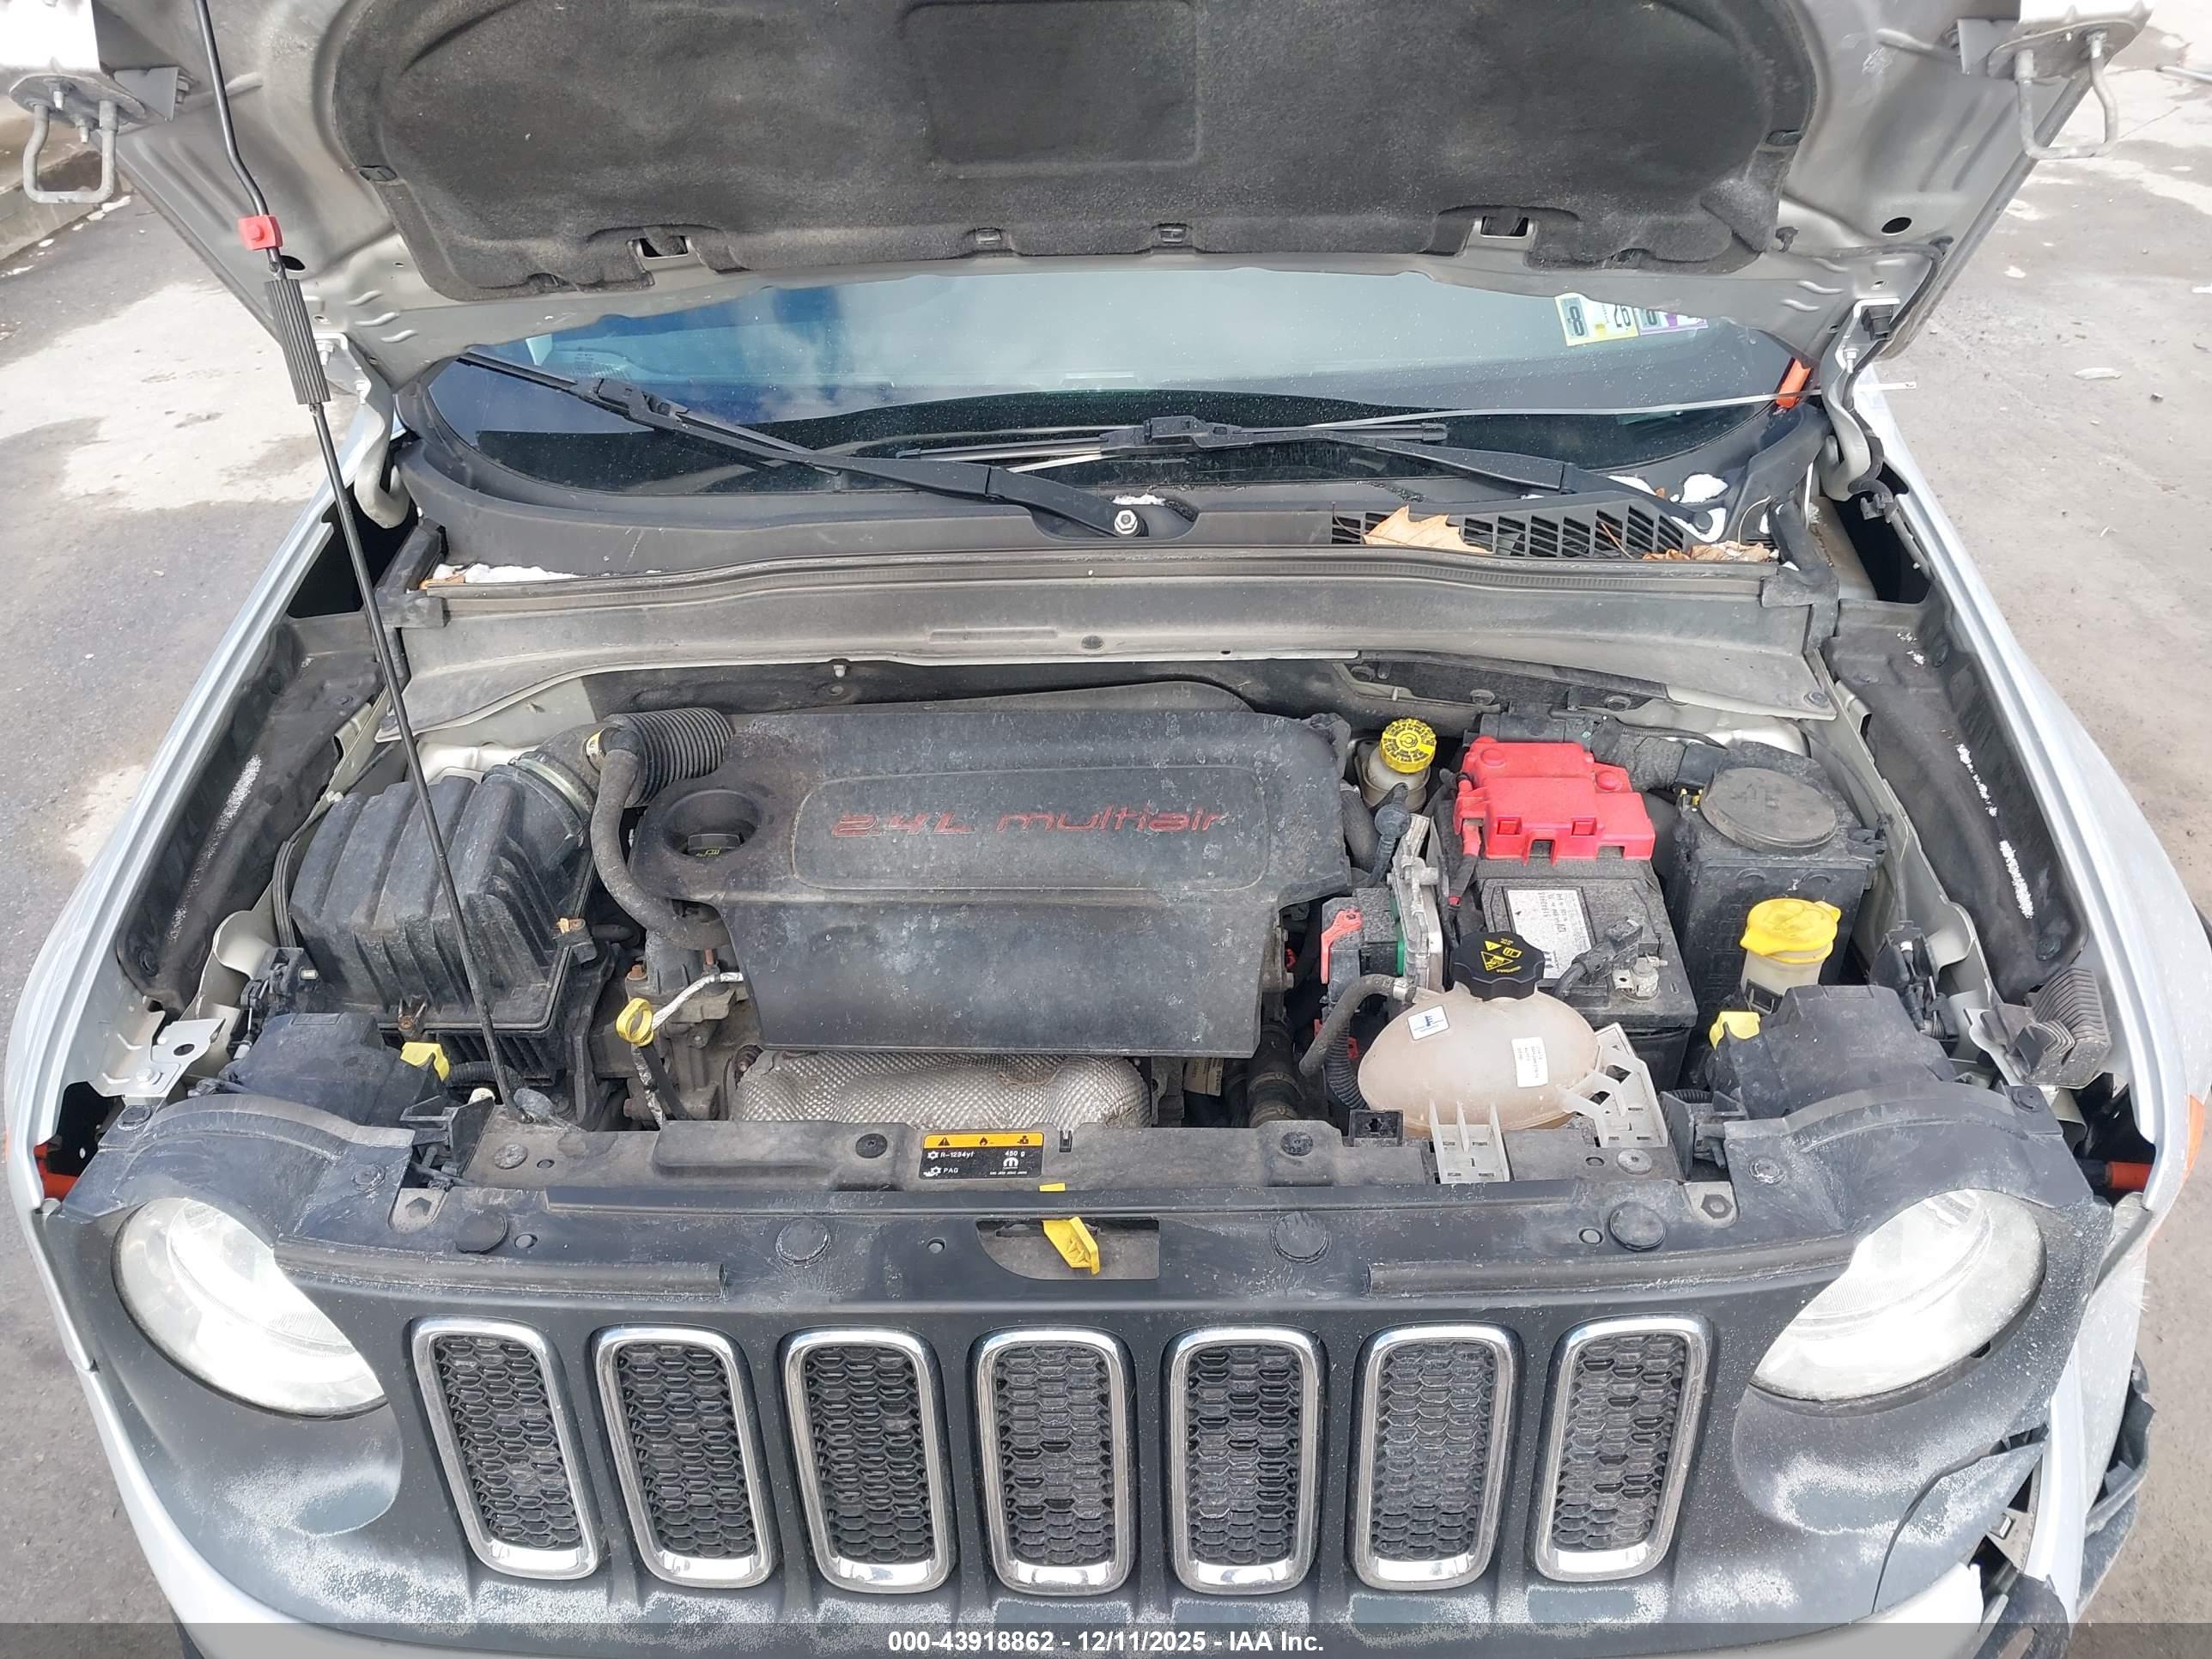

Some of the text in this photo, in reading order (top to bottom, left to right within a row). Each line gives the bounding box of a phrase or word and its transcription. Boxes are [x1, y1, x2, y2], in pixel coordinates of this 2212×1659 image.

[1570, 306, 1585, 337] 8
[830, 804, 1229, 838] 2.4L multiair
